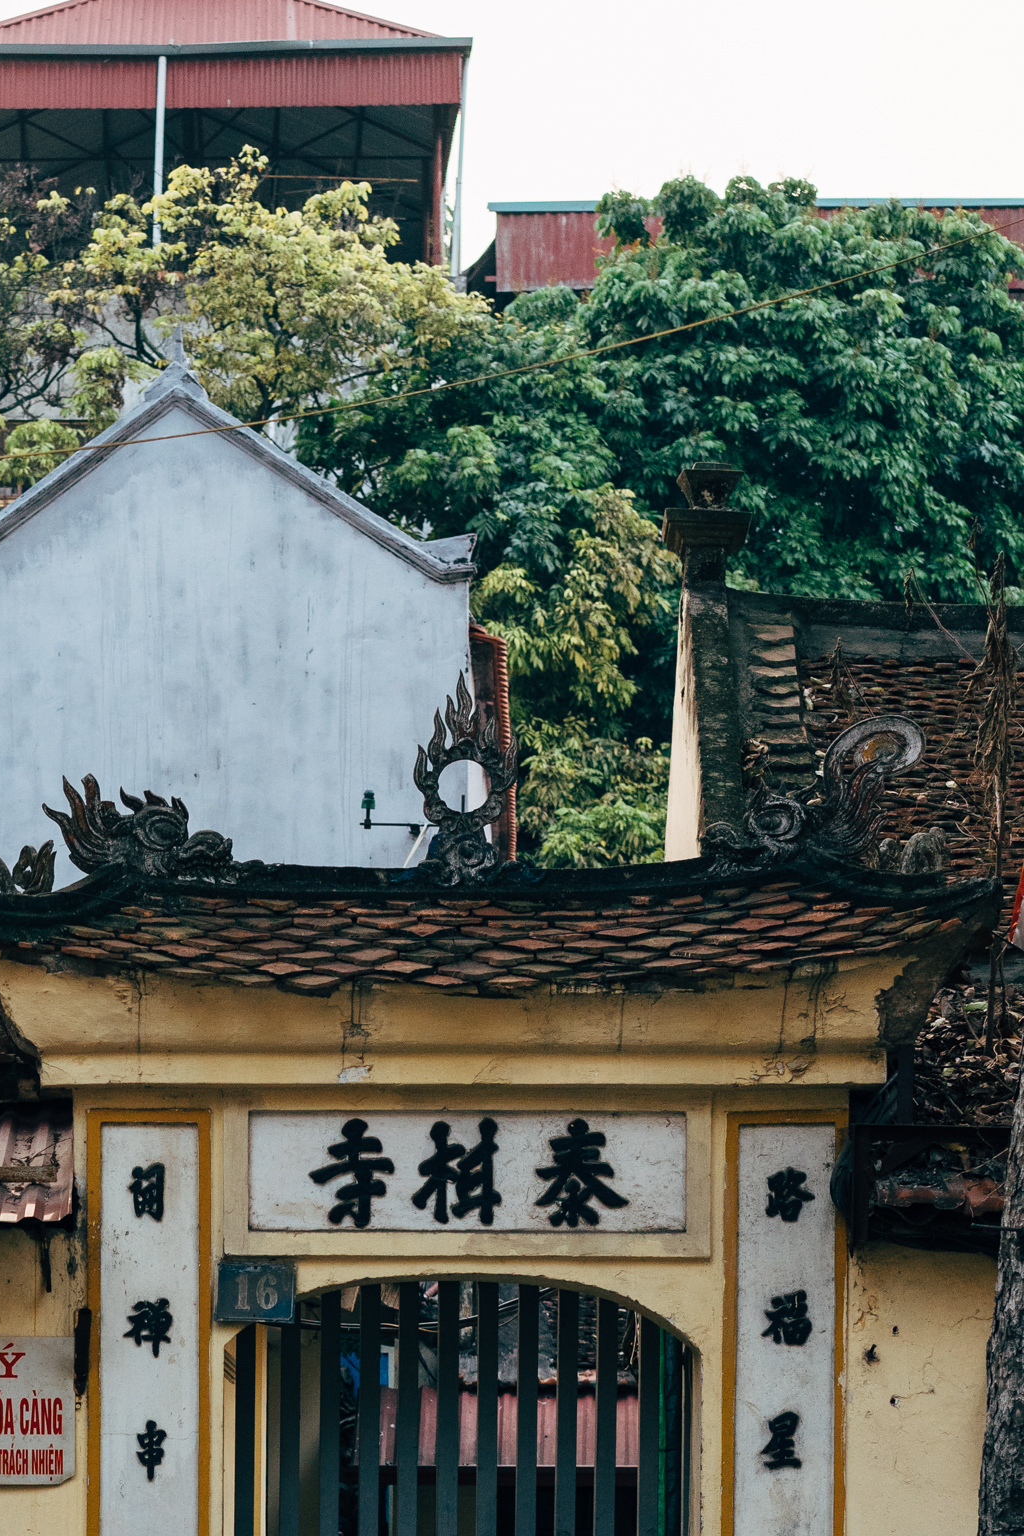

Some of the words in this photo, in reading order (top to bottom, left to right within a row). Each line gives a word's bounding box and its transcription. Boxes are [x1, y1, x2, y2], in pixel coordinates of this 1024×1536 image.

[234, 1273, 278, 1310] 16
[19, 1390, 63, 1435] CÀNG
[31, 1444, 64, 1481] NHIỆM
